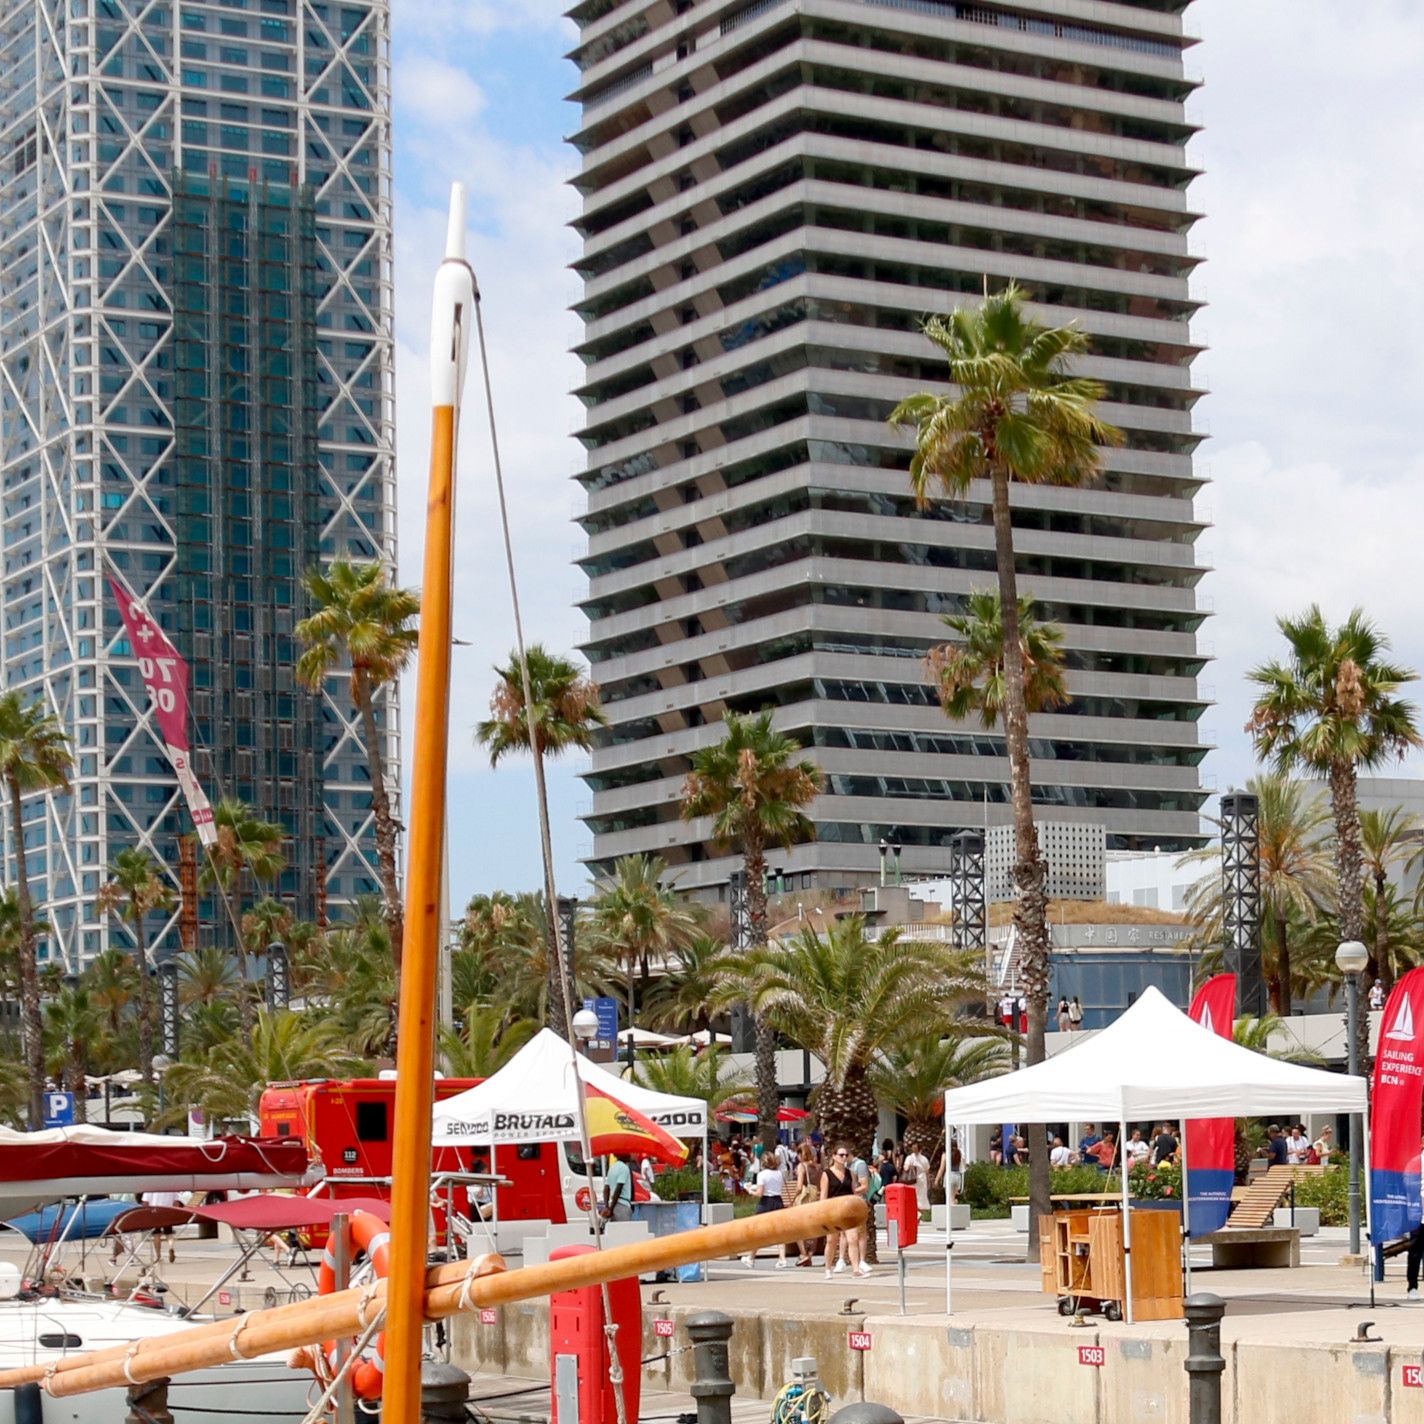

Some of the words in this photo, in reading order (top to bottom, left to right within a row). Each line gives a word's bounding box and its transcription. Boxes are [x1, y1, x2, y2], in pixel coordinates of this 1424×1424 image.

[1383, 1049, 1414, 1062] SAILING
[1381, 1061, 1423, 1076] EXPERIENCE
[1380, 1074, 1398, 1085] BCN
[49, 1094, 68, 1119] P
[494, 1113, 574, 1131] BRUTAL
[344, 1150, 357, 1159] 112
[656, 1322, 673, 1335] 1505
[851, 1334, 870, 1348] 1504
[1081, 1349, 1103, 1363] 1503
